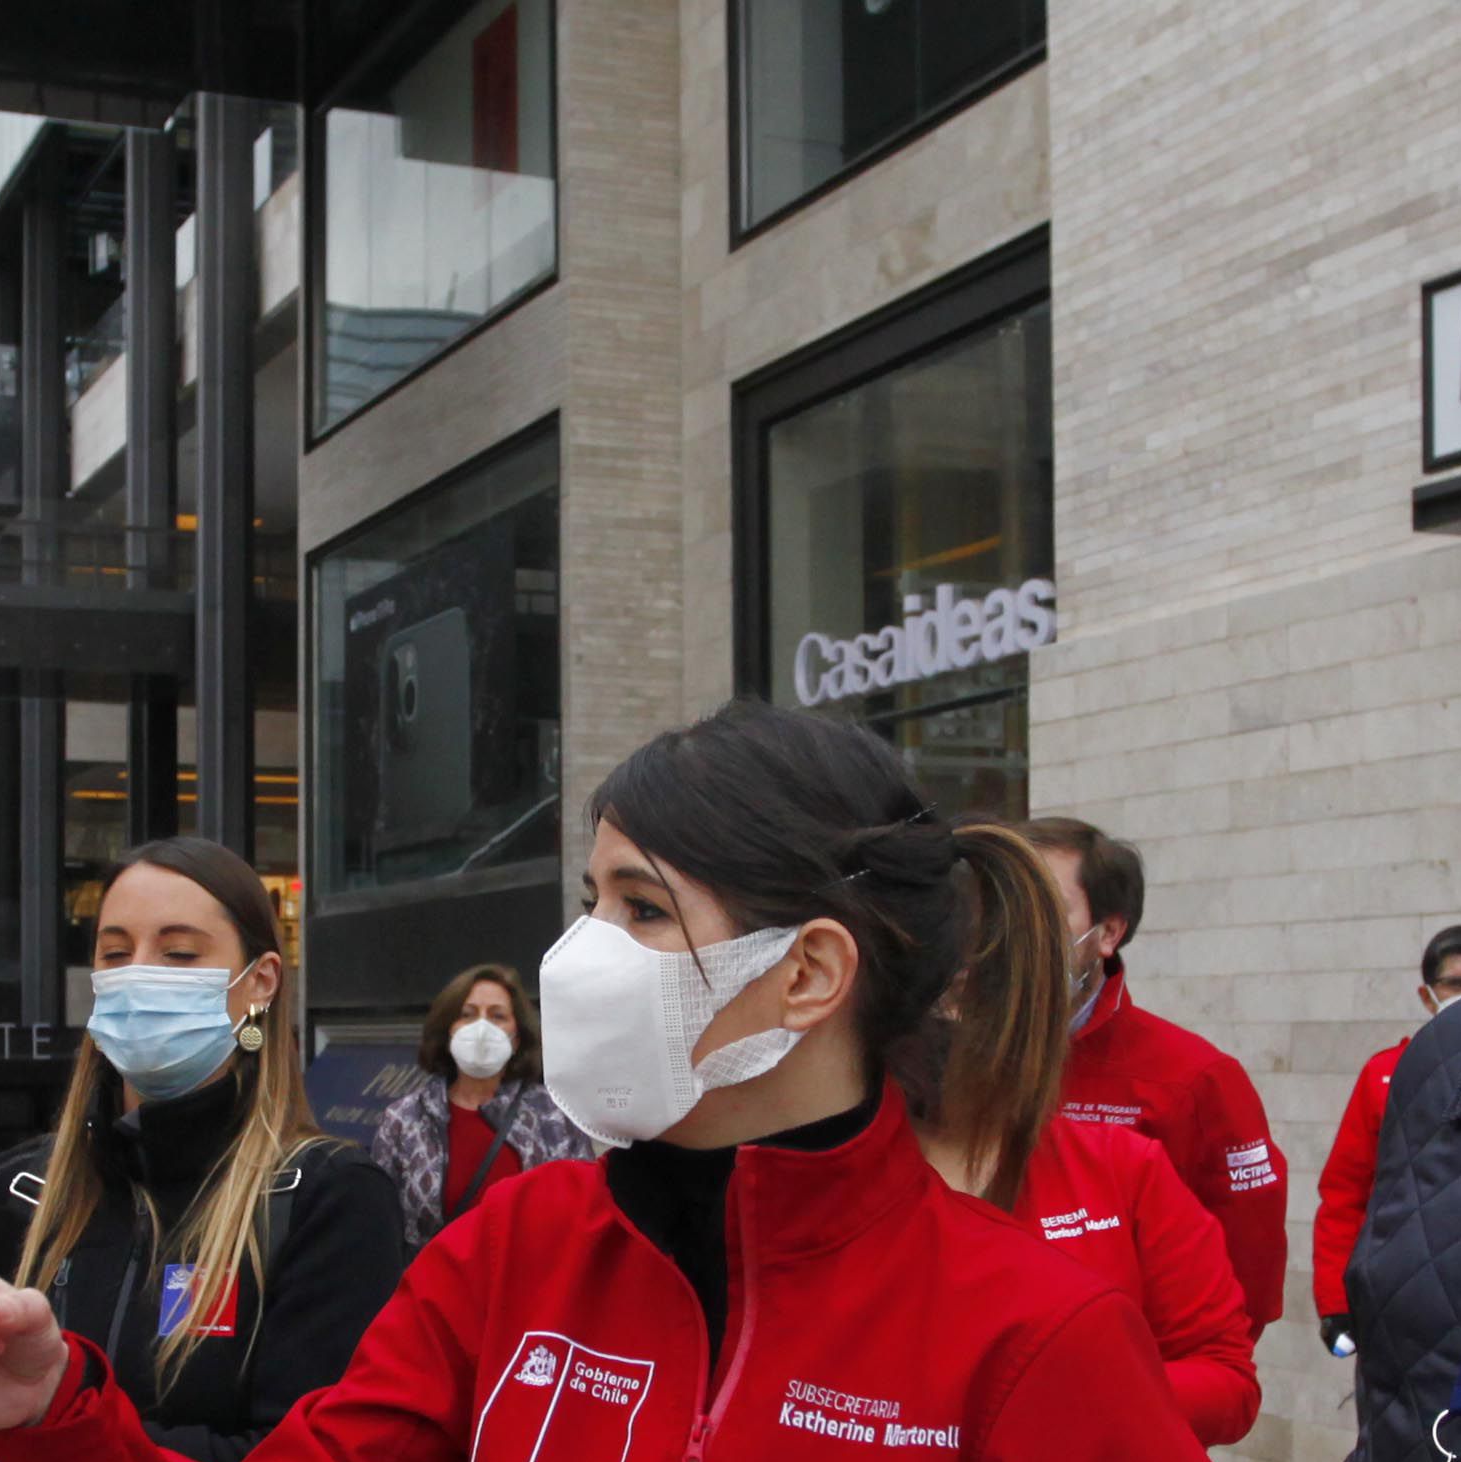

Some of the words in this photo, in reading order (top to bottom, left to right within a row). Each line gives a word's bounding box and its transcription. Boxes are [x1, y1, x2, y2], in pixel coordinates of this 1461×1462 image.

[794, 578, 1056, 706] Casaideas
[1040, 1207, 1088, 1228] SEREMI
[569, 1377, 587, 1393] de
[591, 1384, 629, 1405] Chile
[574, 1361, 640, 1391] Gobierno
[785, 1379, 901, 1419] SUBSECRETARIA
[779, 1401, 875, 1443] Katherine
[883, 1423, 961, 1449] Martorell
